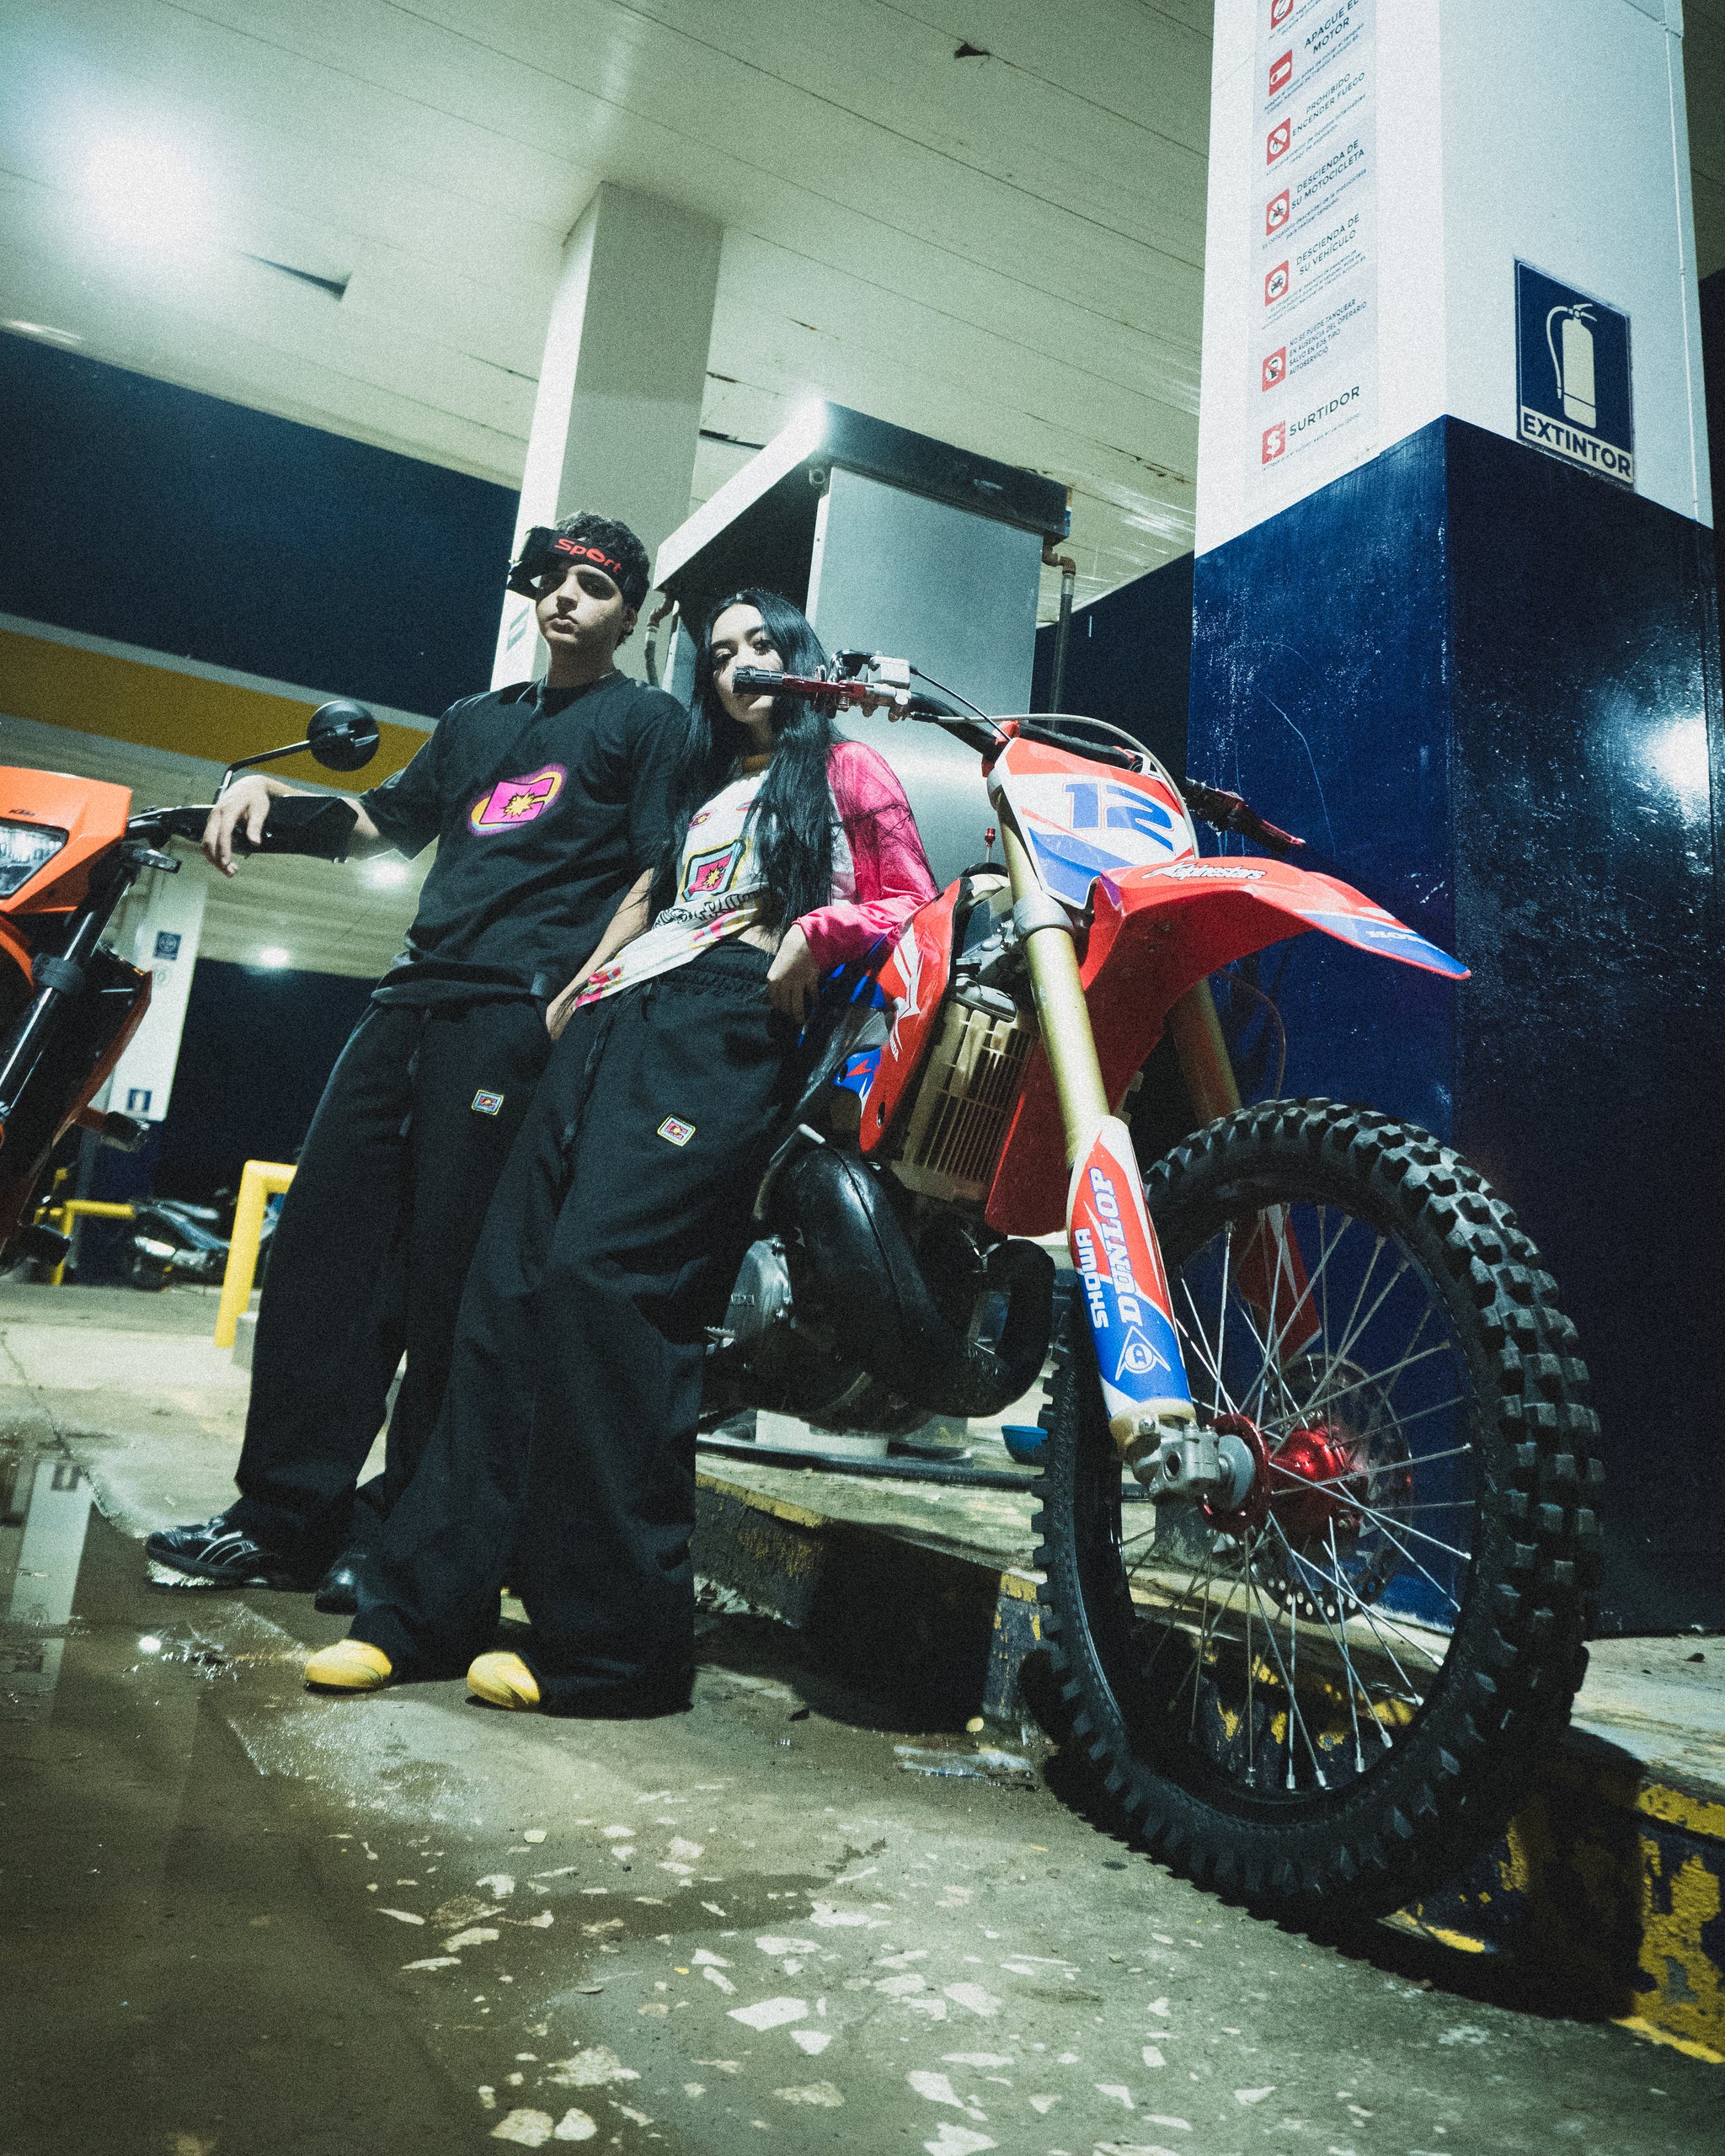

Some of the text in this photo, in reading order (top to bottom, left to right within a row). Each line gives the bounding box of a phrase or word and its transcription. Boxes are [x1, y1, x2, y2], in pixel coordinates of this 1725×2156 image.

[1305, 8, 1344, 47] APAGUE
[1313, 18, 1349, 54] MOTOR
[1292, 97, 1334, 136] ENCENDER
[1306, 73, 1349, 113] PROHIBIDO
[1292, 148, 1365, 209] SU MOTOCICLETA
[1297, 141, 1358, 192] DESCIENDA DE
[1297, 214, 1359, 264] DESCIENDA DE
[1300, 228, 1356, 275] SU VEHÍCULO
[1290, 299, 1355, 347] NO SE PUEDE TANQUEAR
[1290, 301, 1366, 356] EN AUSENCIA DEL OPERARIO
[1290, 351, 1306, 366] SALVO
[1307, 344, 1315, 355] EN
[1327, 328, 1341, 340] TIPO
[1290, 345, 1329, 376] AUTOSERVICIO
[1290, 387, 1359, 435] SURTIDOR
[1524, 412, 1632, 478] EXTINTOR
[1065, 782, 1175, 852] 12
[1089, 1166, 1143, 1327] DUNLOP
[1074, 1228, 1108, 1328] SHOWA
